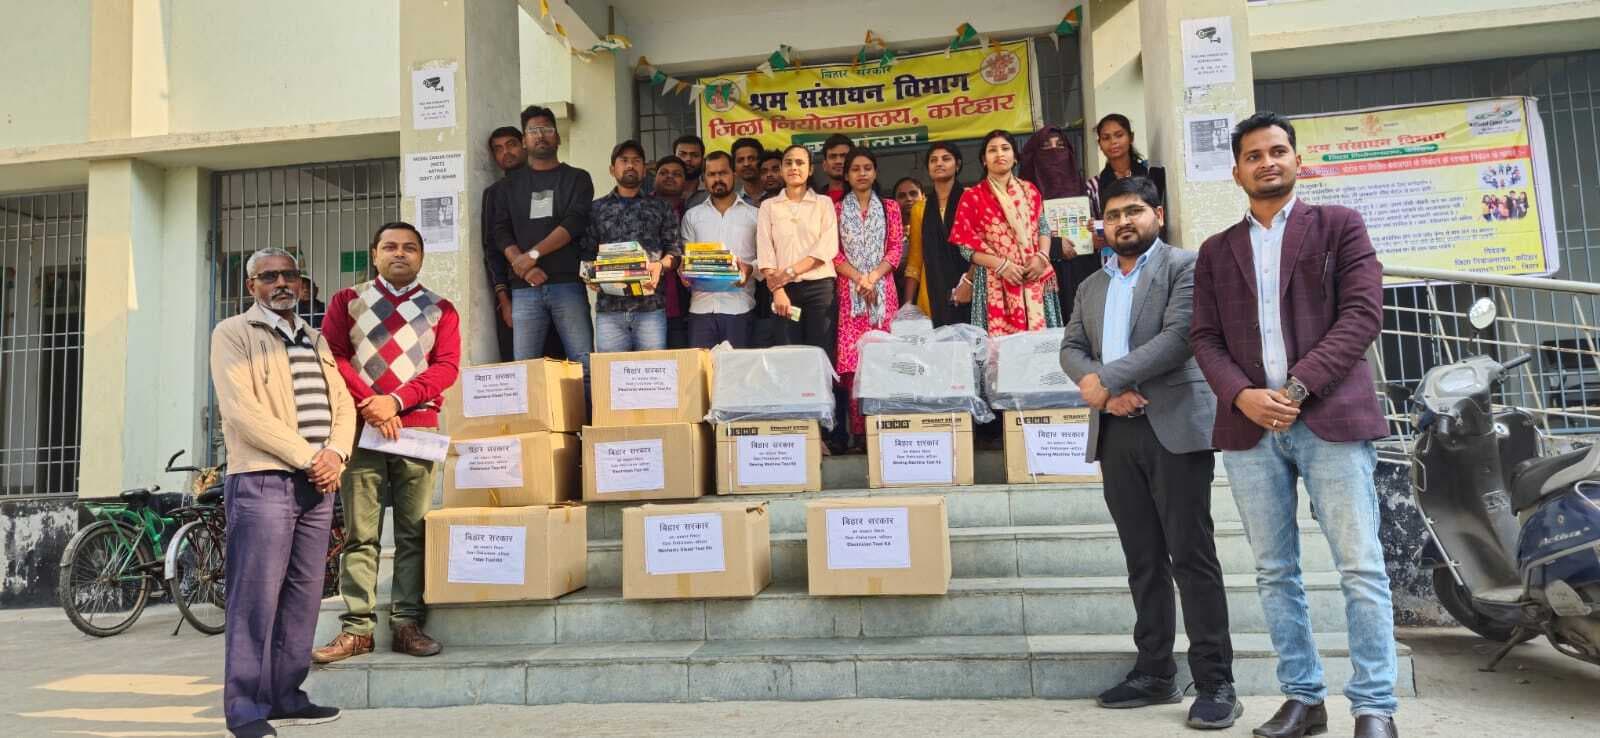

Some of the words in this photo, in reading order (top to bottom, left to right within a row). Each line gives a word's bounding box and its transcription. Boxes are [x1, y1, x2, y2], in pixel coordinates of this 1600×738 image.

[821, 69, 848, 79] बिहार
[856, 65, 891, 76] सरकार
[749, 92, 788, 111] श्रम
[796, 82, 886, 109] संसाधन
[893, 73, 970, 100] विभाग
[709, 117, 764, 139] जिला
[770, 107, 920, 132] नियोजनालय,
[927, 95, 1015, 119] कटिहार
[876, 419, 910, 429] SHA
[727, 427, 758, 436] SHA
